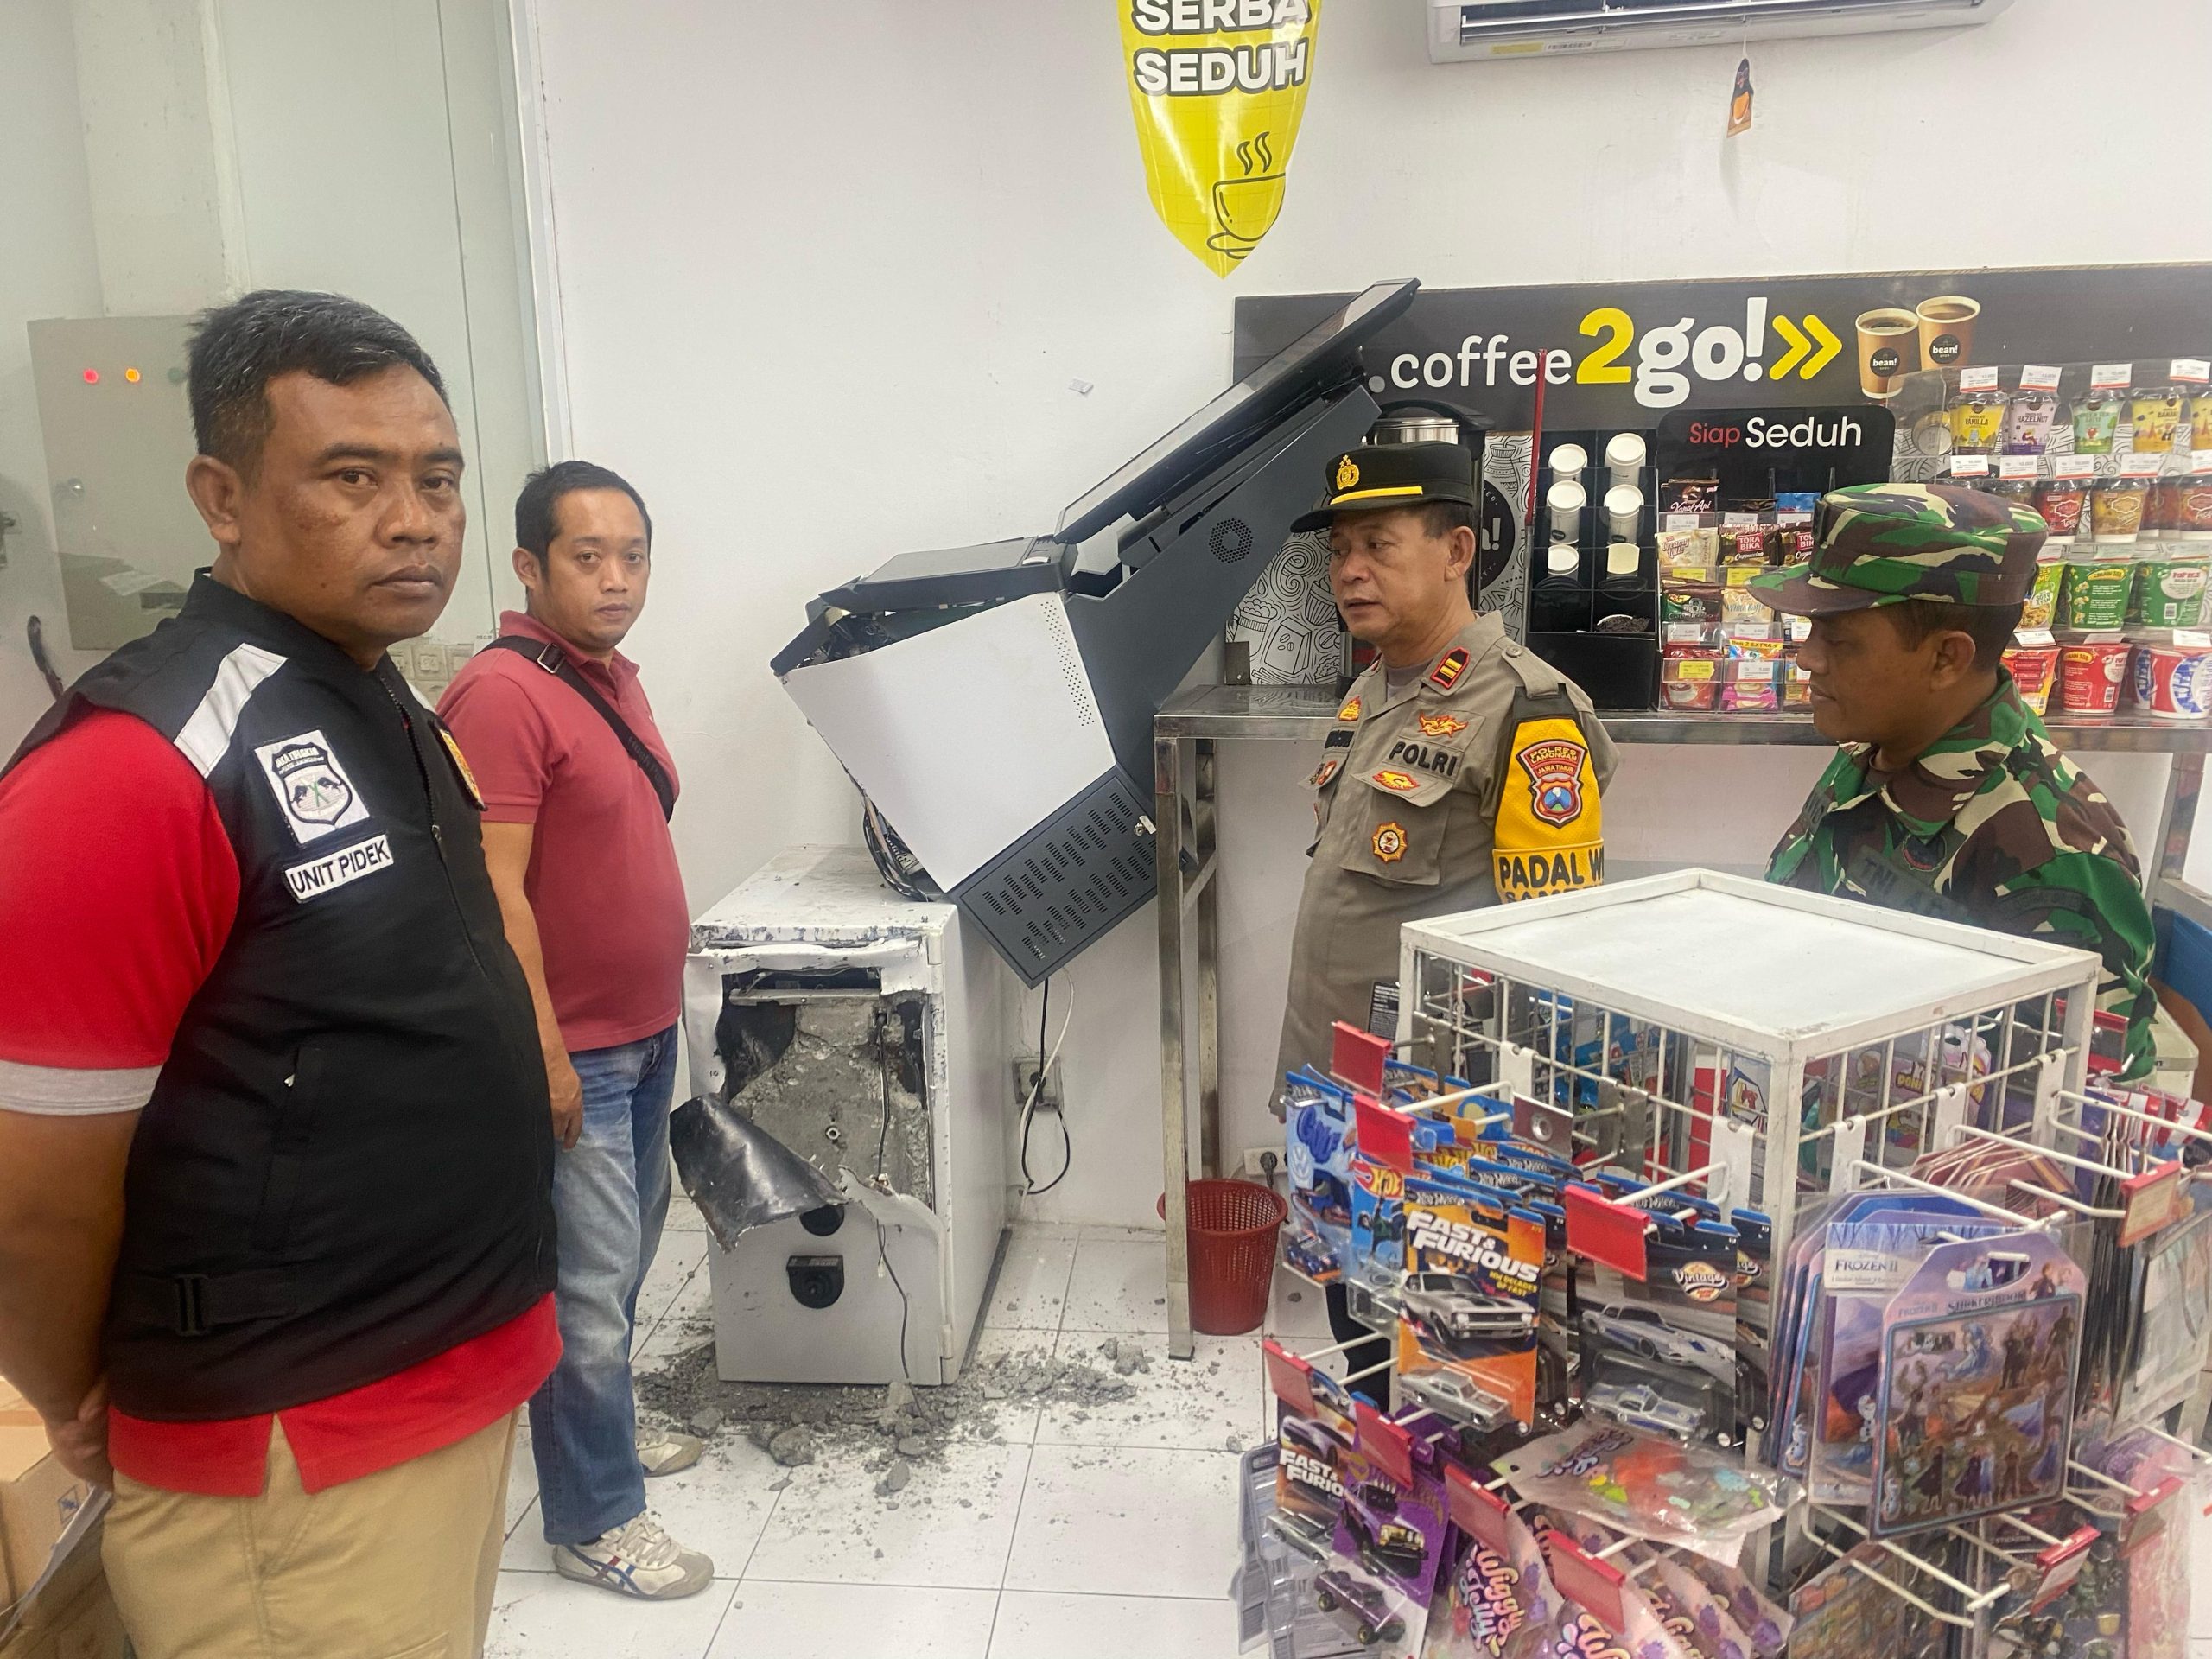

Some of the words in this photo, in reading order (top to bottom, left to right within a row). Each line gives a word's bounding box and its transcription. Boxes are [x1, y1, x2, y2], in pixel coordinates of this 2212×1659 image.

[1135, 0, 1309, 31] SERBA
[1135, 41, 1306, 92] SEDUH
[1872, 357, 1897, 367] bean!
[1932, 344, 1959, 354] bean!
[1688, 422, 1741, 448] Siap
[1745, 416, 1862, 448] Seduh
[1965, 417, 1989, 426] VANILLA
[1388, 741, 1459, 776] POLRI
[1529, 747, 1577, 760] POLRES
[1530, 752, 1578, 764] LAMONGAN
[1538, 764, 1555, 774] JAWA
[1555, 764, 1574, 773] TIMUR
[289, 861, 335, 893] UNIT
[340, 840, 391, 878] PIDEK
[1498, 852, 1585, 889] PADAL
[1406, 1211, 1488, 1245] FAST
[1483, 1236, 1496, 1250] &
[1412, 1229, 1541, 1282] FURIOUS
[1835, 1259, 1888, 1272] FROZEN
[1889, 1259, 1898, 1272] II
[1502, 1274, 1539, 1294] DECADES
[1672, 1268, 1726, 1285] Vintage
[1279, 1448, 1332, 1478] FAST
[1286, 1464, 1344, 1497] FURIO
